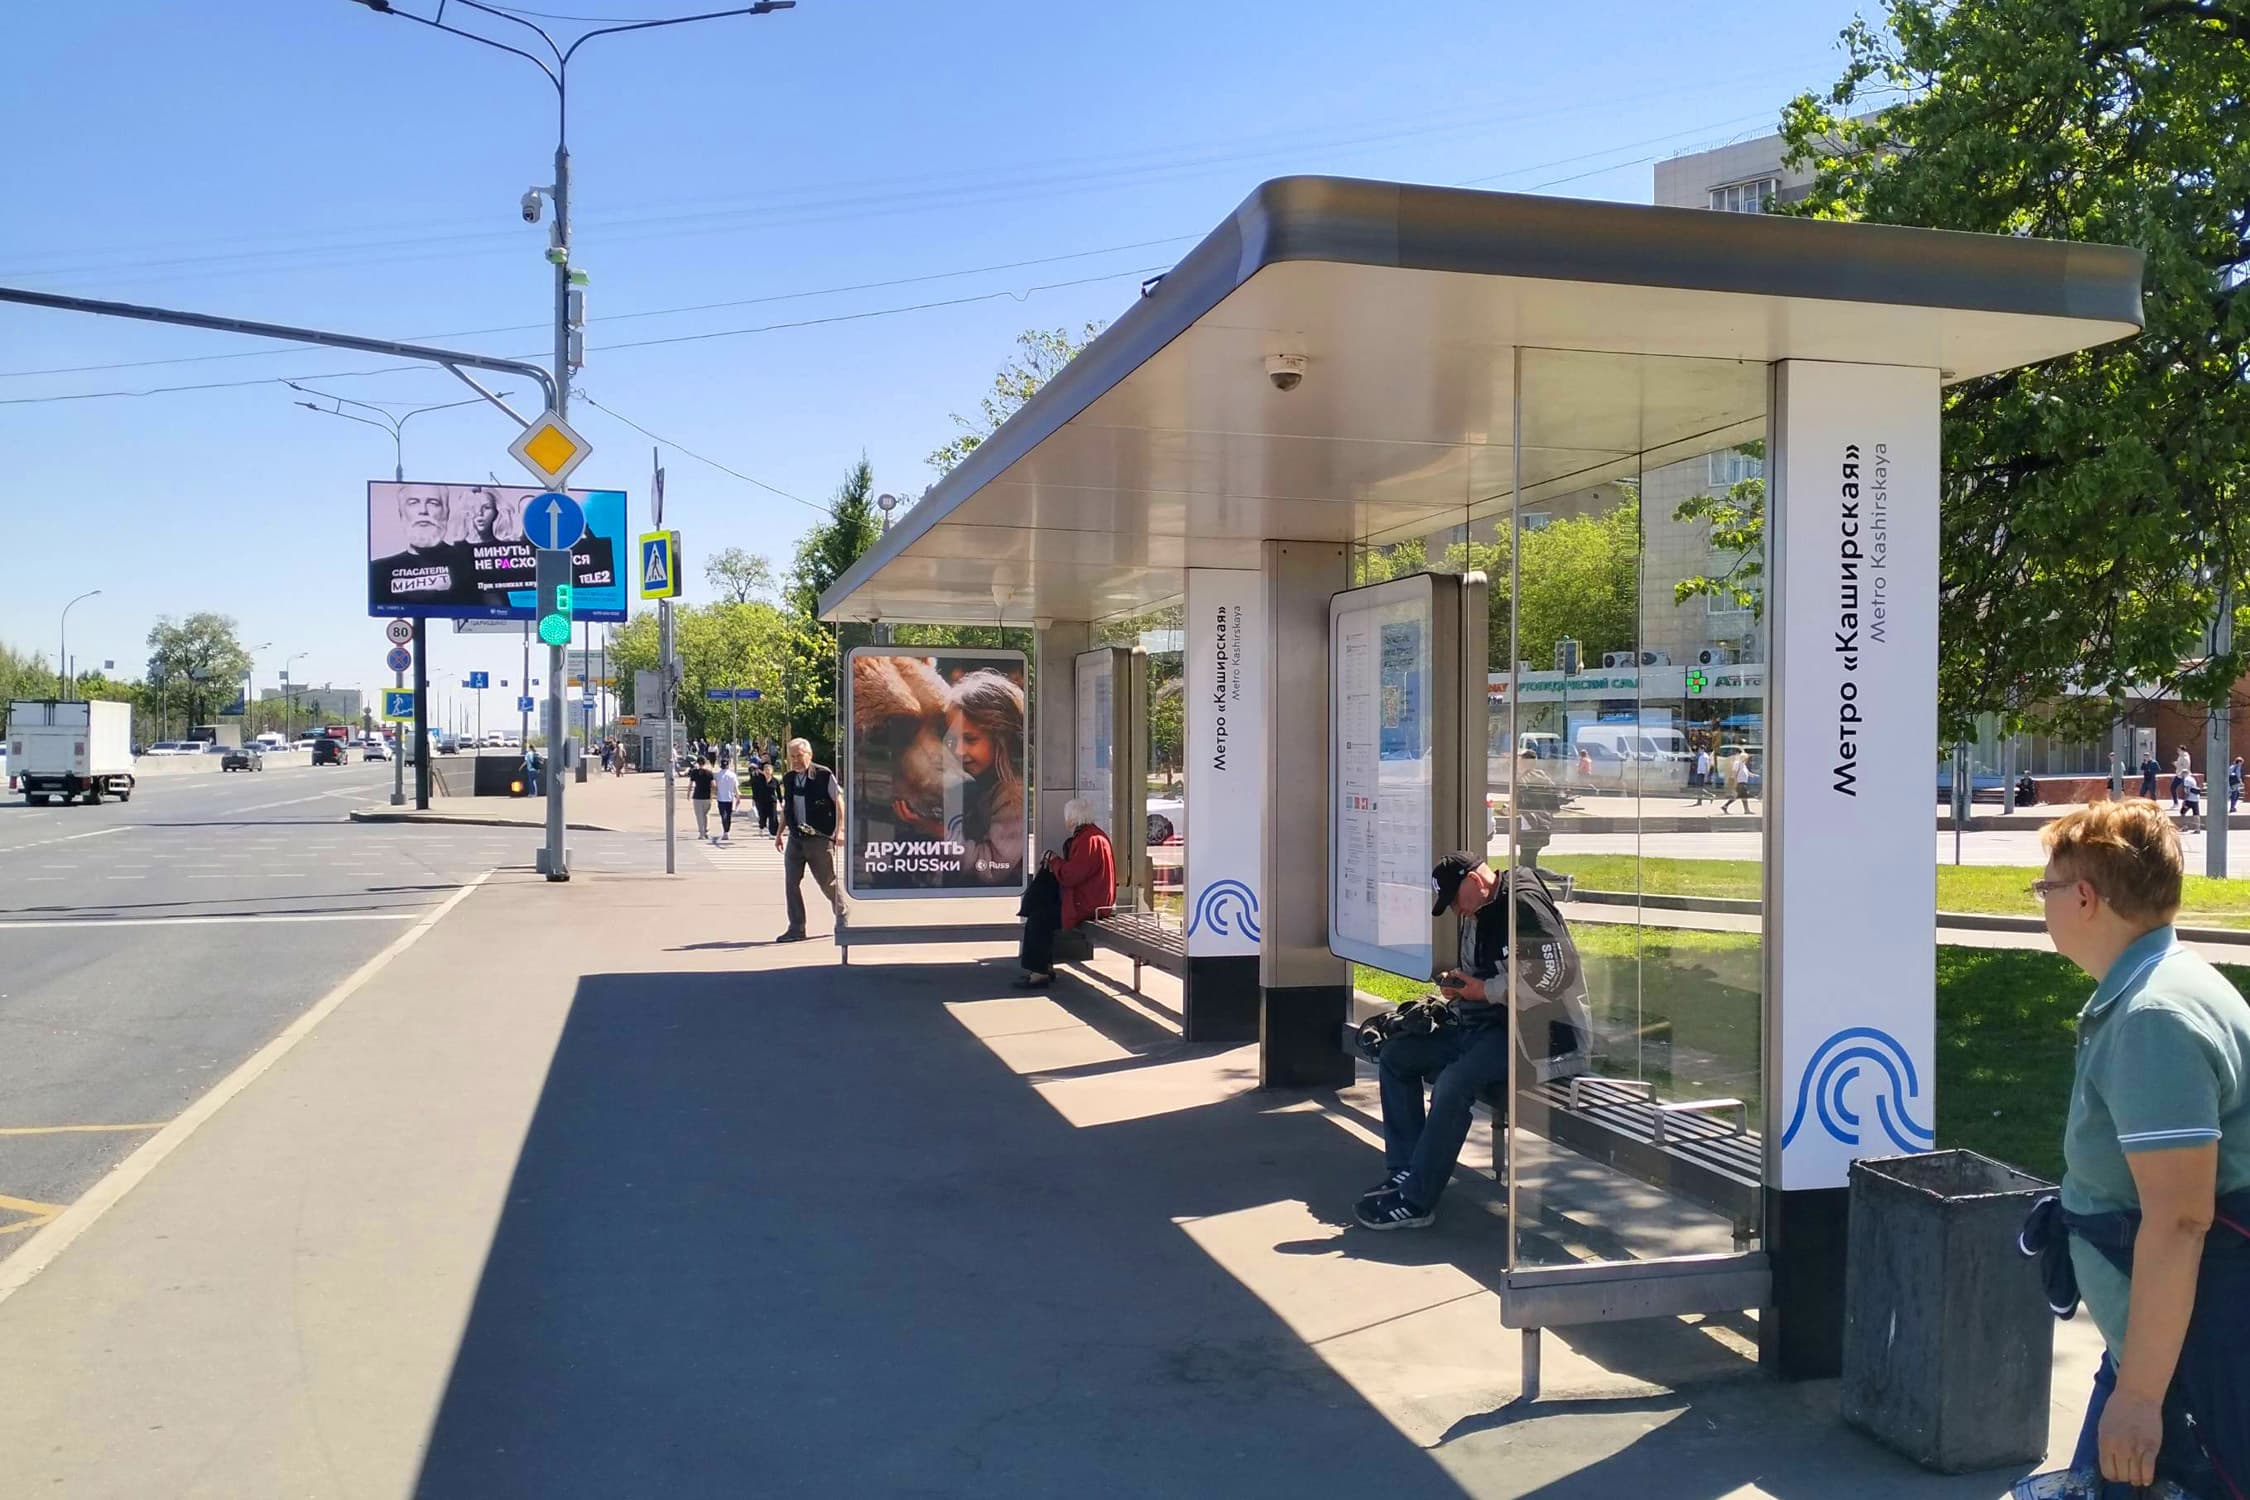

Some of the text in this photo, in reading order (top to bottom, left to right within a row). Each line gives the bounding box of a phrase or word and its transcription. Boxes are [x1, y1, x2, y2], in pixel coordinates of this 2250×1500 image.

[1869, 442, 1891, 644] Metro Kashirskaya
[474, 545, 530, 559] МИНУТЫ
[391, 566, 449, 577] СПАСАТЕЛИ
[475, 558, 493, 570] НЕ
[392, 575, 449, 592] МИНУТ
[579, 570, 611, 584] TELE2
[1833, 444, 1864, 797] Метро «Каширская»
[393, 627, 408, 637] 80
[1231, 605, 1243, 701] Metro Kashirskaya
[1213, 606, 1229, 771] Метро «Каширская»
[864, 841, 965, 858] ДРУЖИТЬ
[865, 859, 960, 873] по-RUSSки
[989, 861, 1010, 870] Russ
[1536, 943, 1556, 988] SSENTIAL
